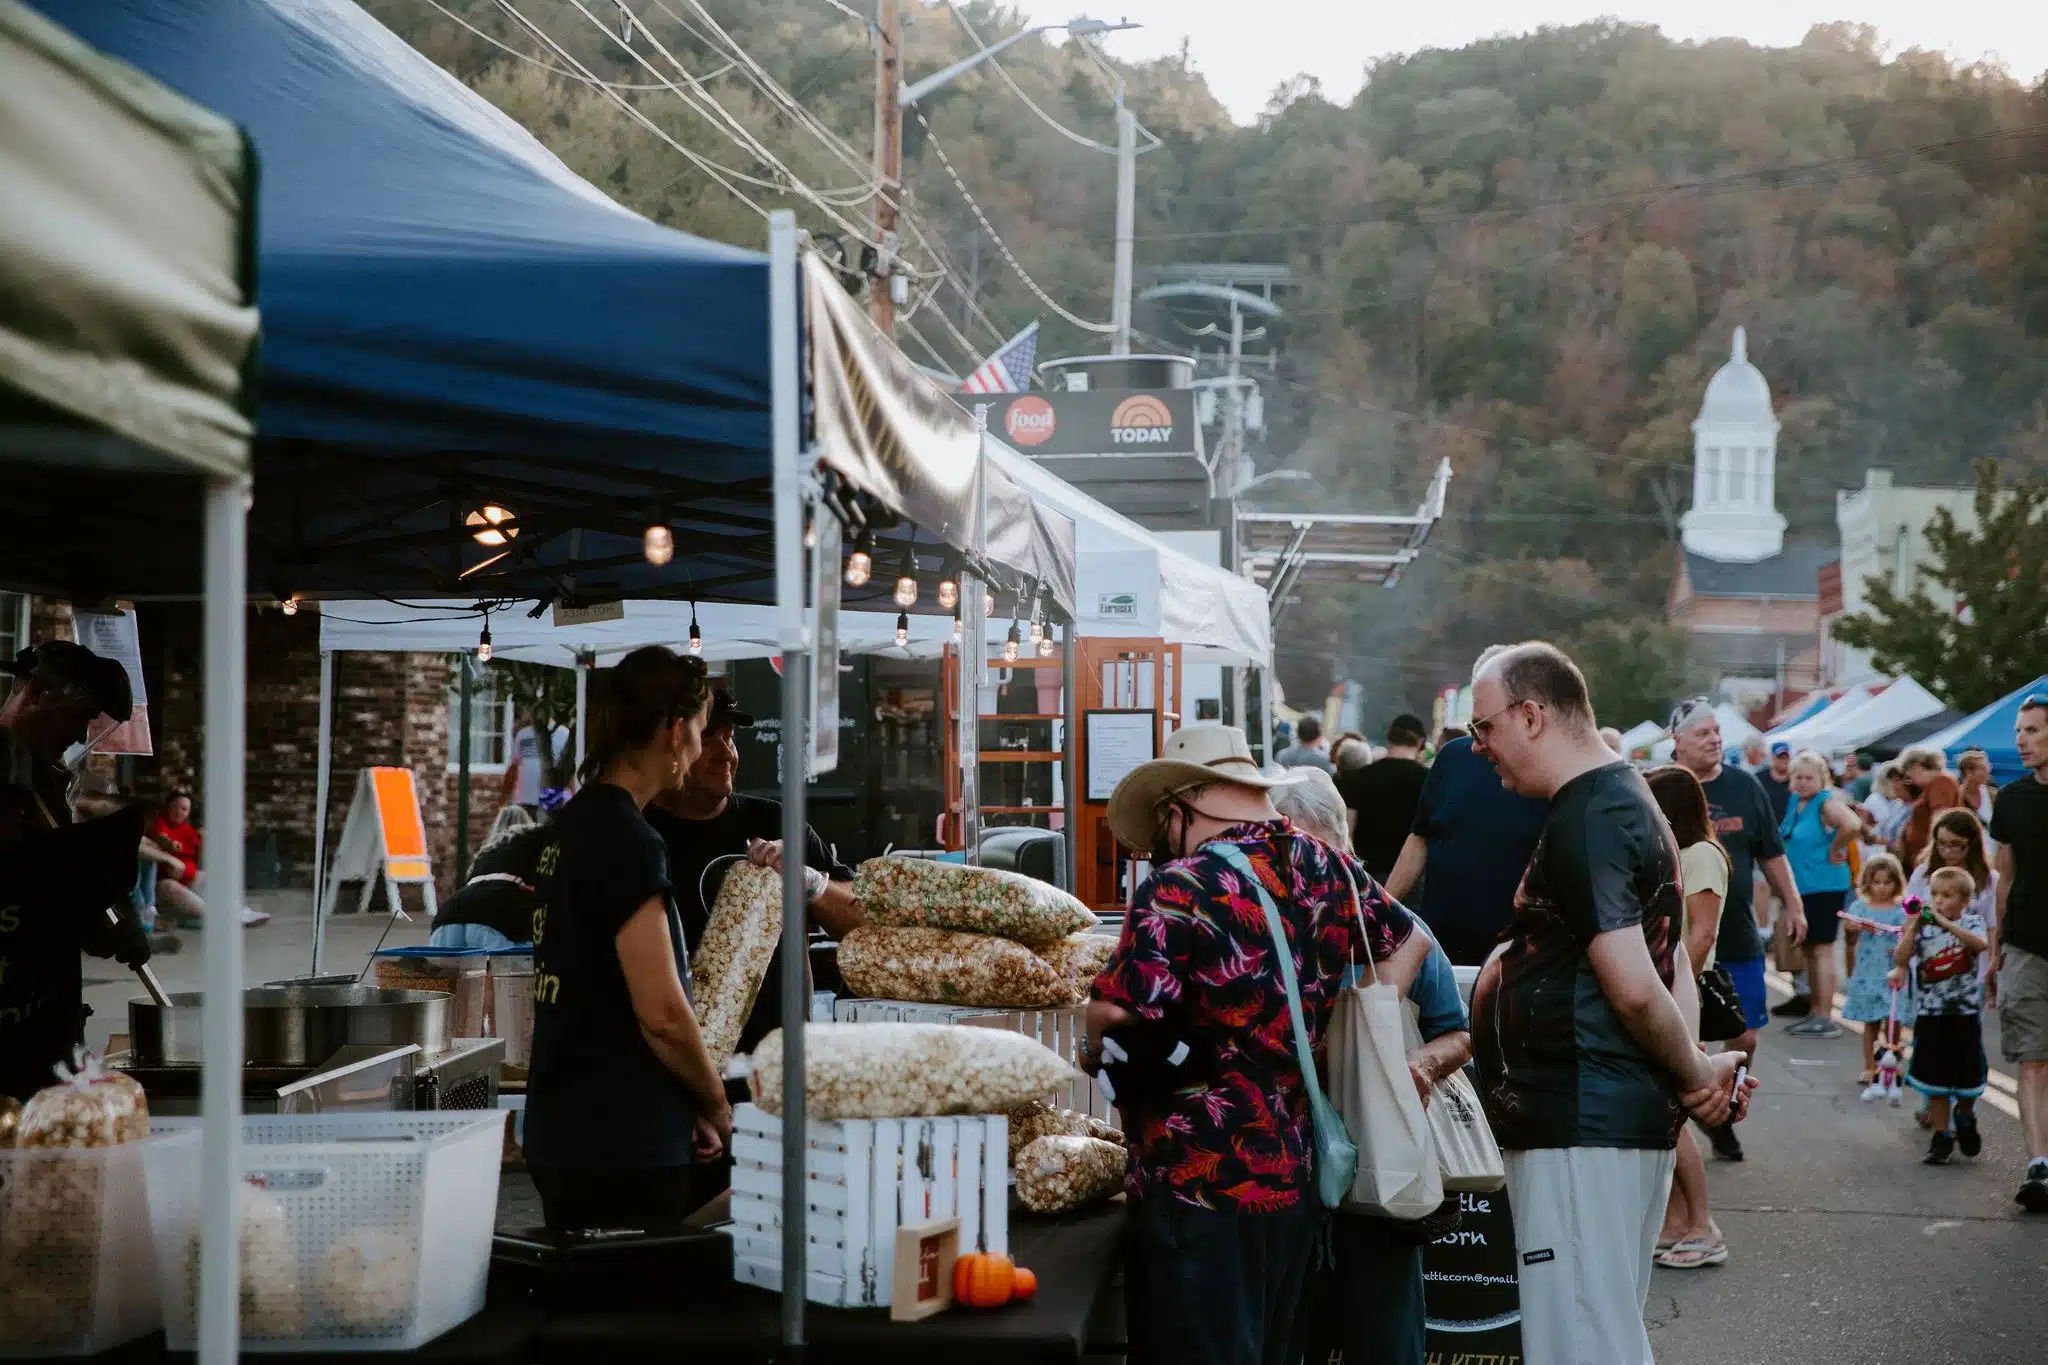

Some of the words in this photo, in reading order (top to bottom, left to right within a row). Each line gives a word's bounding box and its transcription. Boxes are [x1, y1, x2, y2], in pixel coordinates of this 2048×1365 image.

[1008, 407, 1052, 436] food
[1111, 427, 1173, 444] TODAY
[1459, 1192, 1492, 1213] tle
[1421, 1271, 1519, 1286] ettlecorn@gmail.
